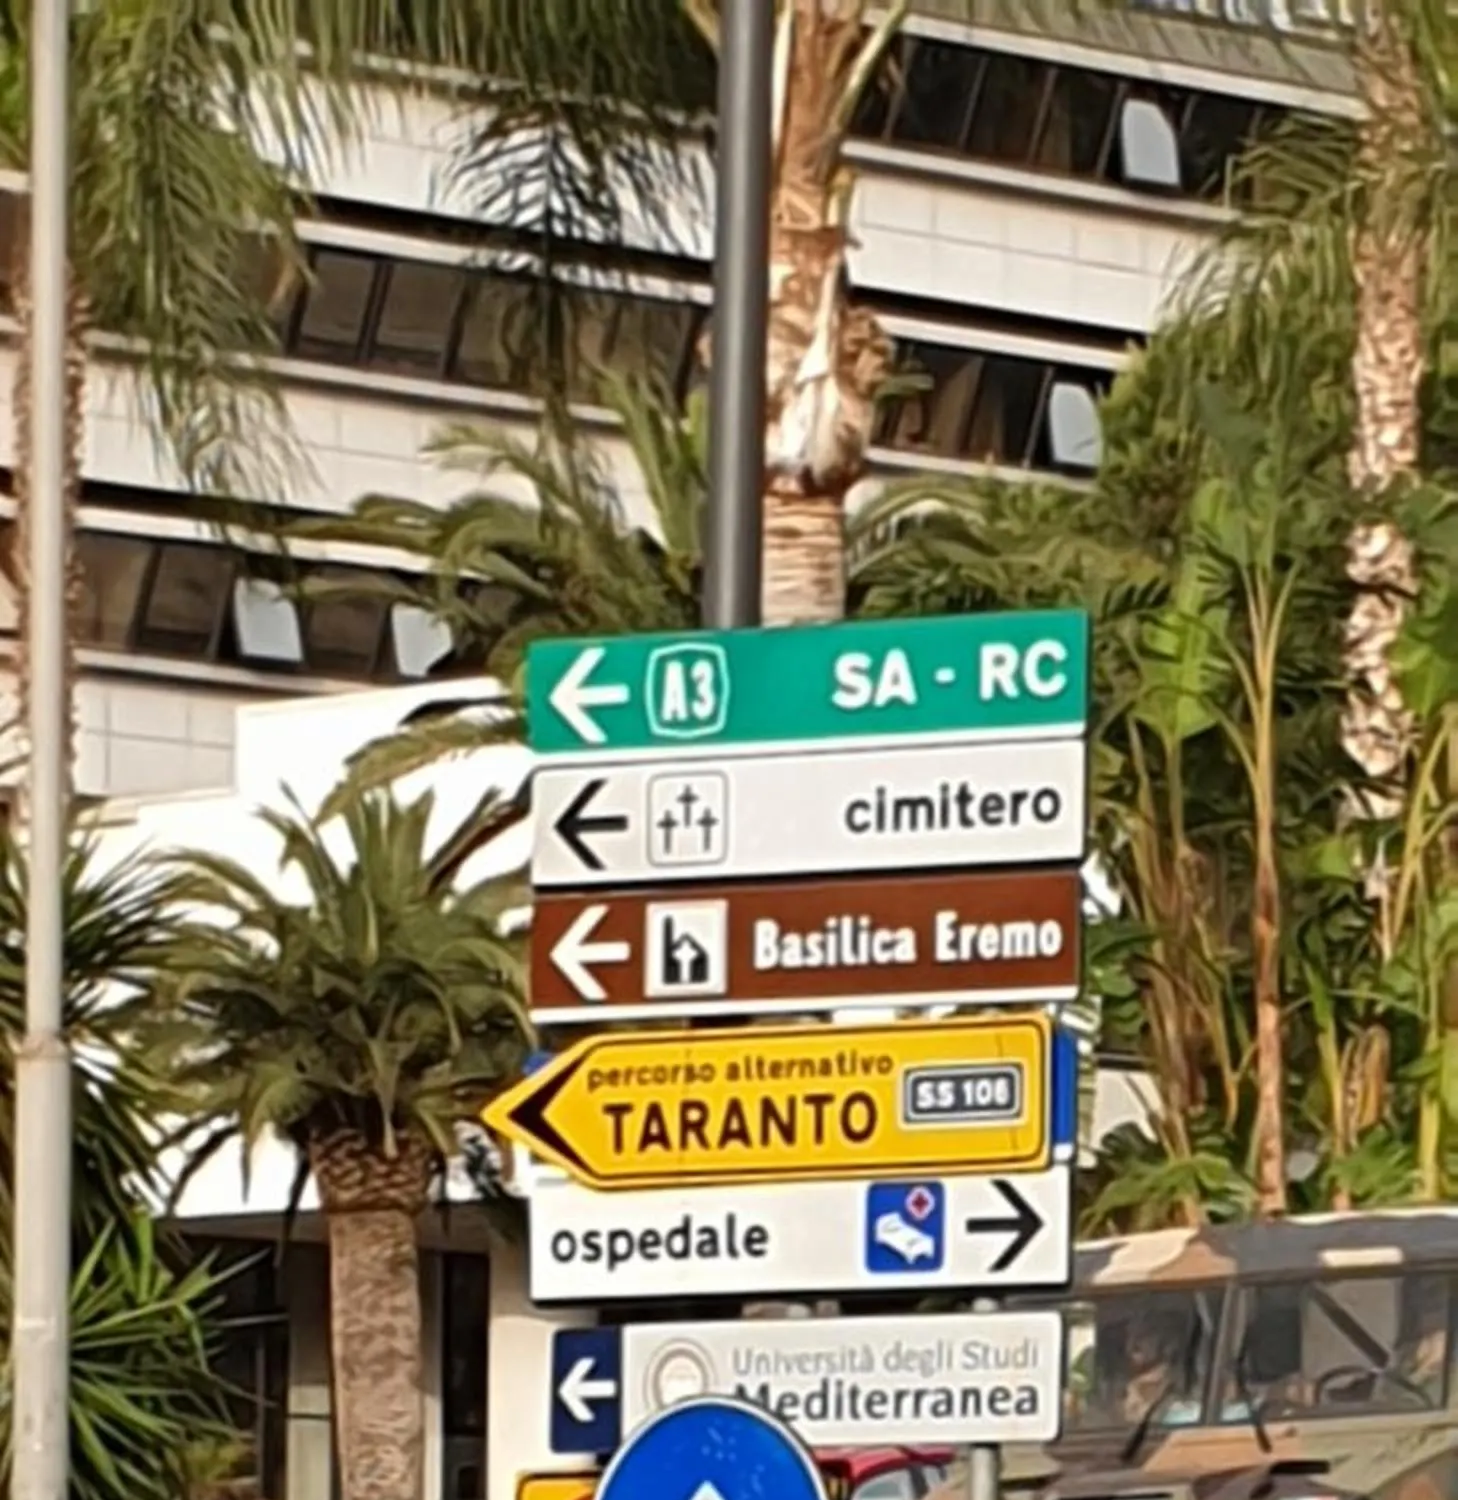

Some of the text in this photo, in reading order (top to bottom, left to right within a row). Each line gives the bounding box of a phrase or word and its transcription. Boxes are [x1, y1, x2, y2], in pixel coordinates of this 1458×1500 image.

[661, 659, 716, 722] A3
[832, 649, 916, 709] SA
[979, 640, 1067, 700] RC
[845, 782, 1062, 833] cimitero
[753, 910, 1063, 970] Basilica Eremo
[587, 1051, 894, 1091] percorso alternativo
[916, 1080, 955, 1109] SS
[603, 1092, 879, 1154] TARANTO
[551, 1214, 770, 1270] ospedale
[733, 1338, 1038, 1378] Università degli Studi
[733, 1378, 1039, 1421] Mediterranea
